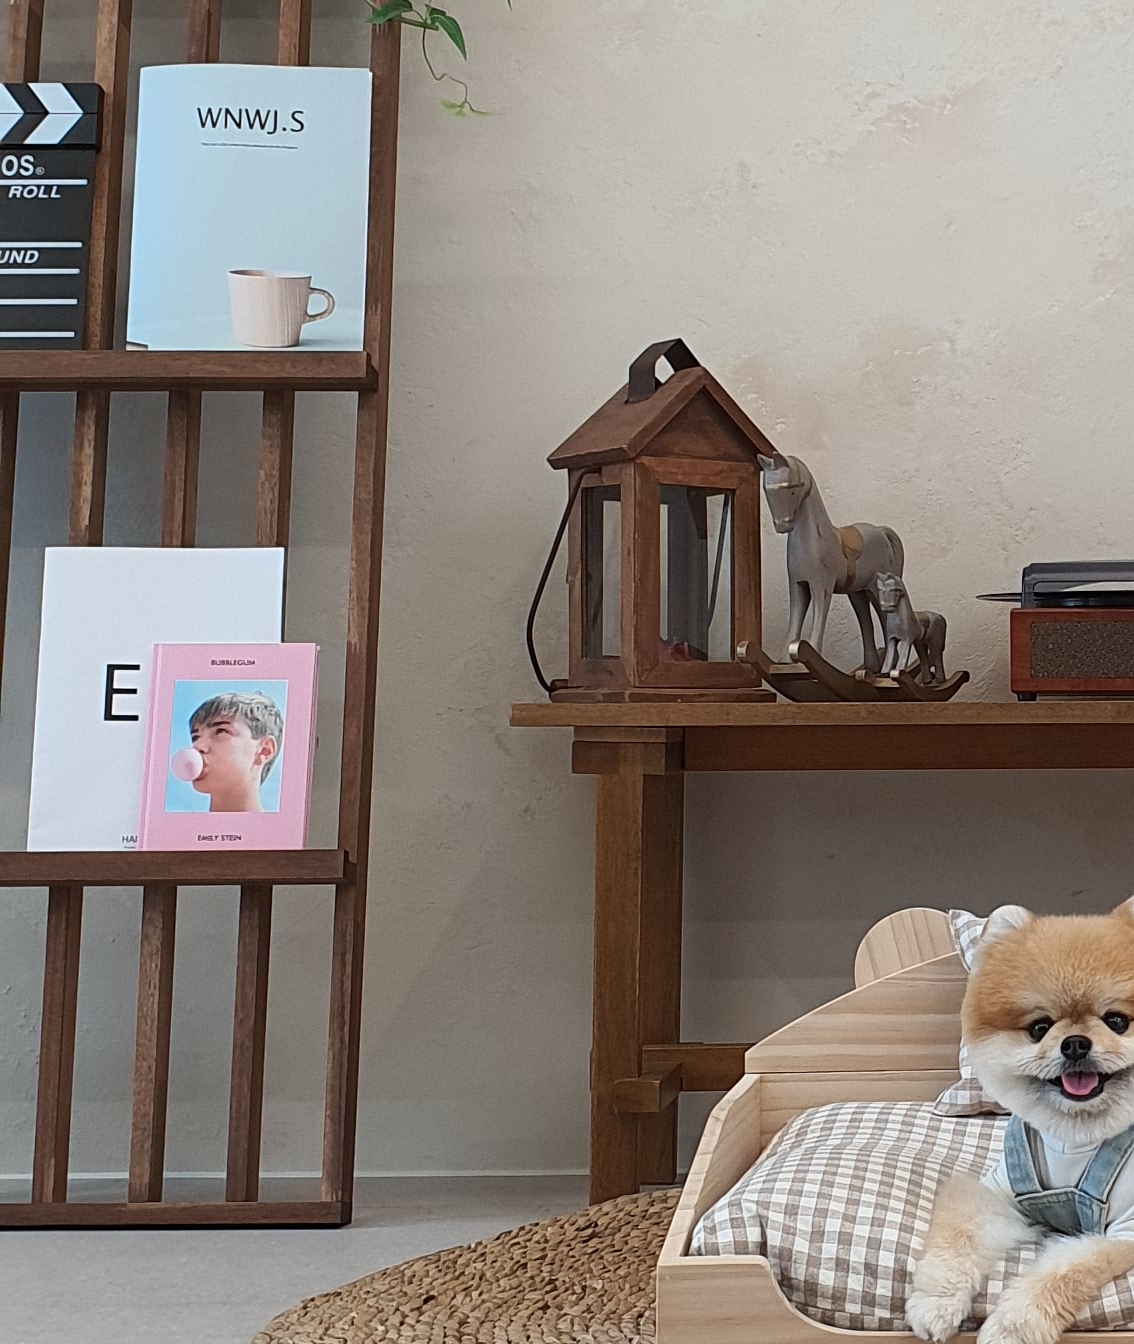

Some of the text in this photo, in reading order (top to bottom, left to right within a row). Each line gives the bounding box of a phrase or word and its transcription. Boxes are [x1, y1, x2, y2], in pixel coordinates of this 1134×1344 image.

[197, 107, 305, 135] WNWJ.S
[8, 185, 61, 199] ROLL
[104, 663, 141, 721] E
